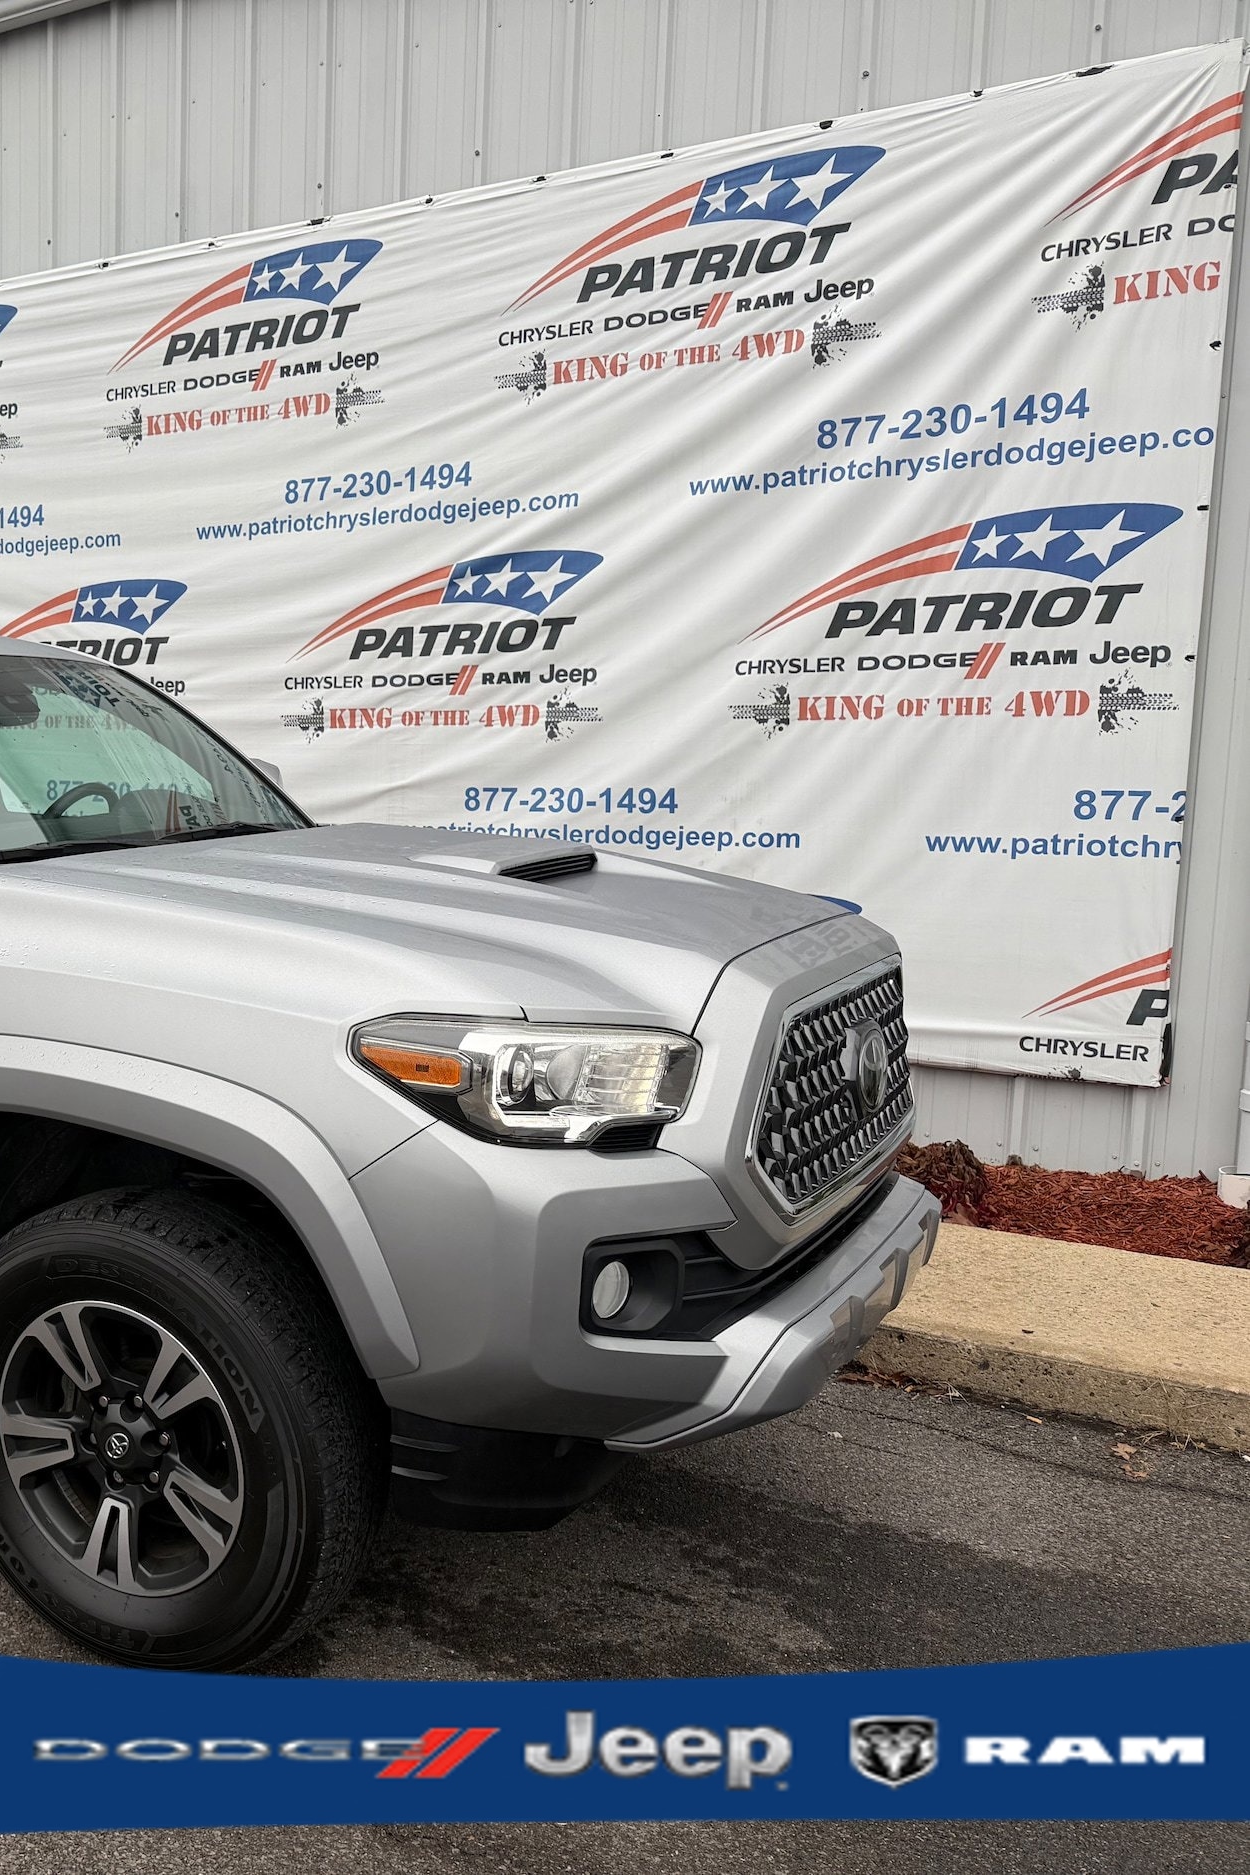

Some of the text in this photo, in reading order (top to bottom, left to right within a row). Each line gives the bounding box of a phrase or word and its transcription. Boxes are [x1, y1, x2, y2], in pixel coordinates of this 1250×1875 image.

[576, 222, 852, 303] PATRIOT
[1040, 223, 1173, 262] CHRYSLER
[1113, 260, 1221, 305] KING
[498, 276, 874, 347] CHRYSLER DODGE RAM Jeep
[162, 303, 361, 366] PATRIOT
[552, 328, 805, 385] KING OF THE 4WD
[106, 351, 379, 402] CHRYSLER DODGE RAM Jeep
[147, 392, 331, 436] KING OF THE 4WD
[816, 387, 1090, 451] 877-230-1494
[284, 461, 472, 504] 877-230-1494
[689, 425, 1214, 497] www.patriotchryslerdodgejeep.co
[196, 490, 580, 541] www.patriotchryslerdodgejeep.com
[824, 583, 1144, 639] PATRIOT
[349, 616, 577, 660] PATRIOT
[735, 640, 1171, 677] CHRYSLER DODGE RAM Jeep
[284, 664, 597, 690] CHRYSLER DODGE RAM Jeep
[329, 704, 540, 729] KING OF THE 4WD
[797, 689, 1090, 722] KING OF THE 4WD
[464, 786, 678, 815] 877-230-1494
[1019, 1036, 1149, 1062] CHRYSLER
